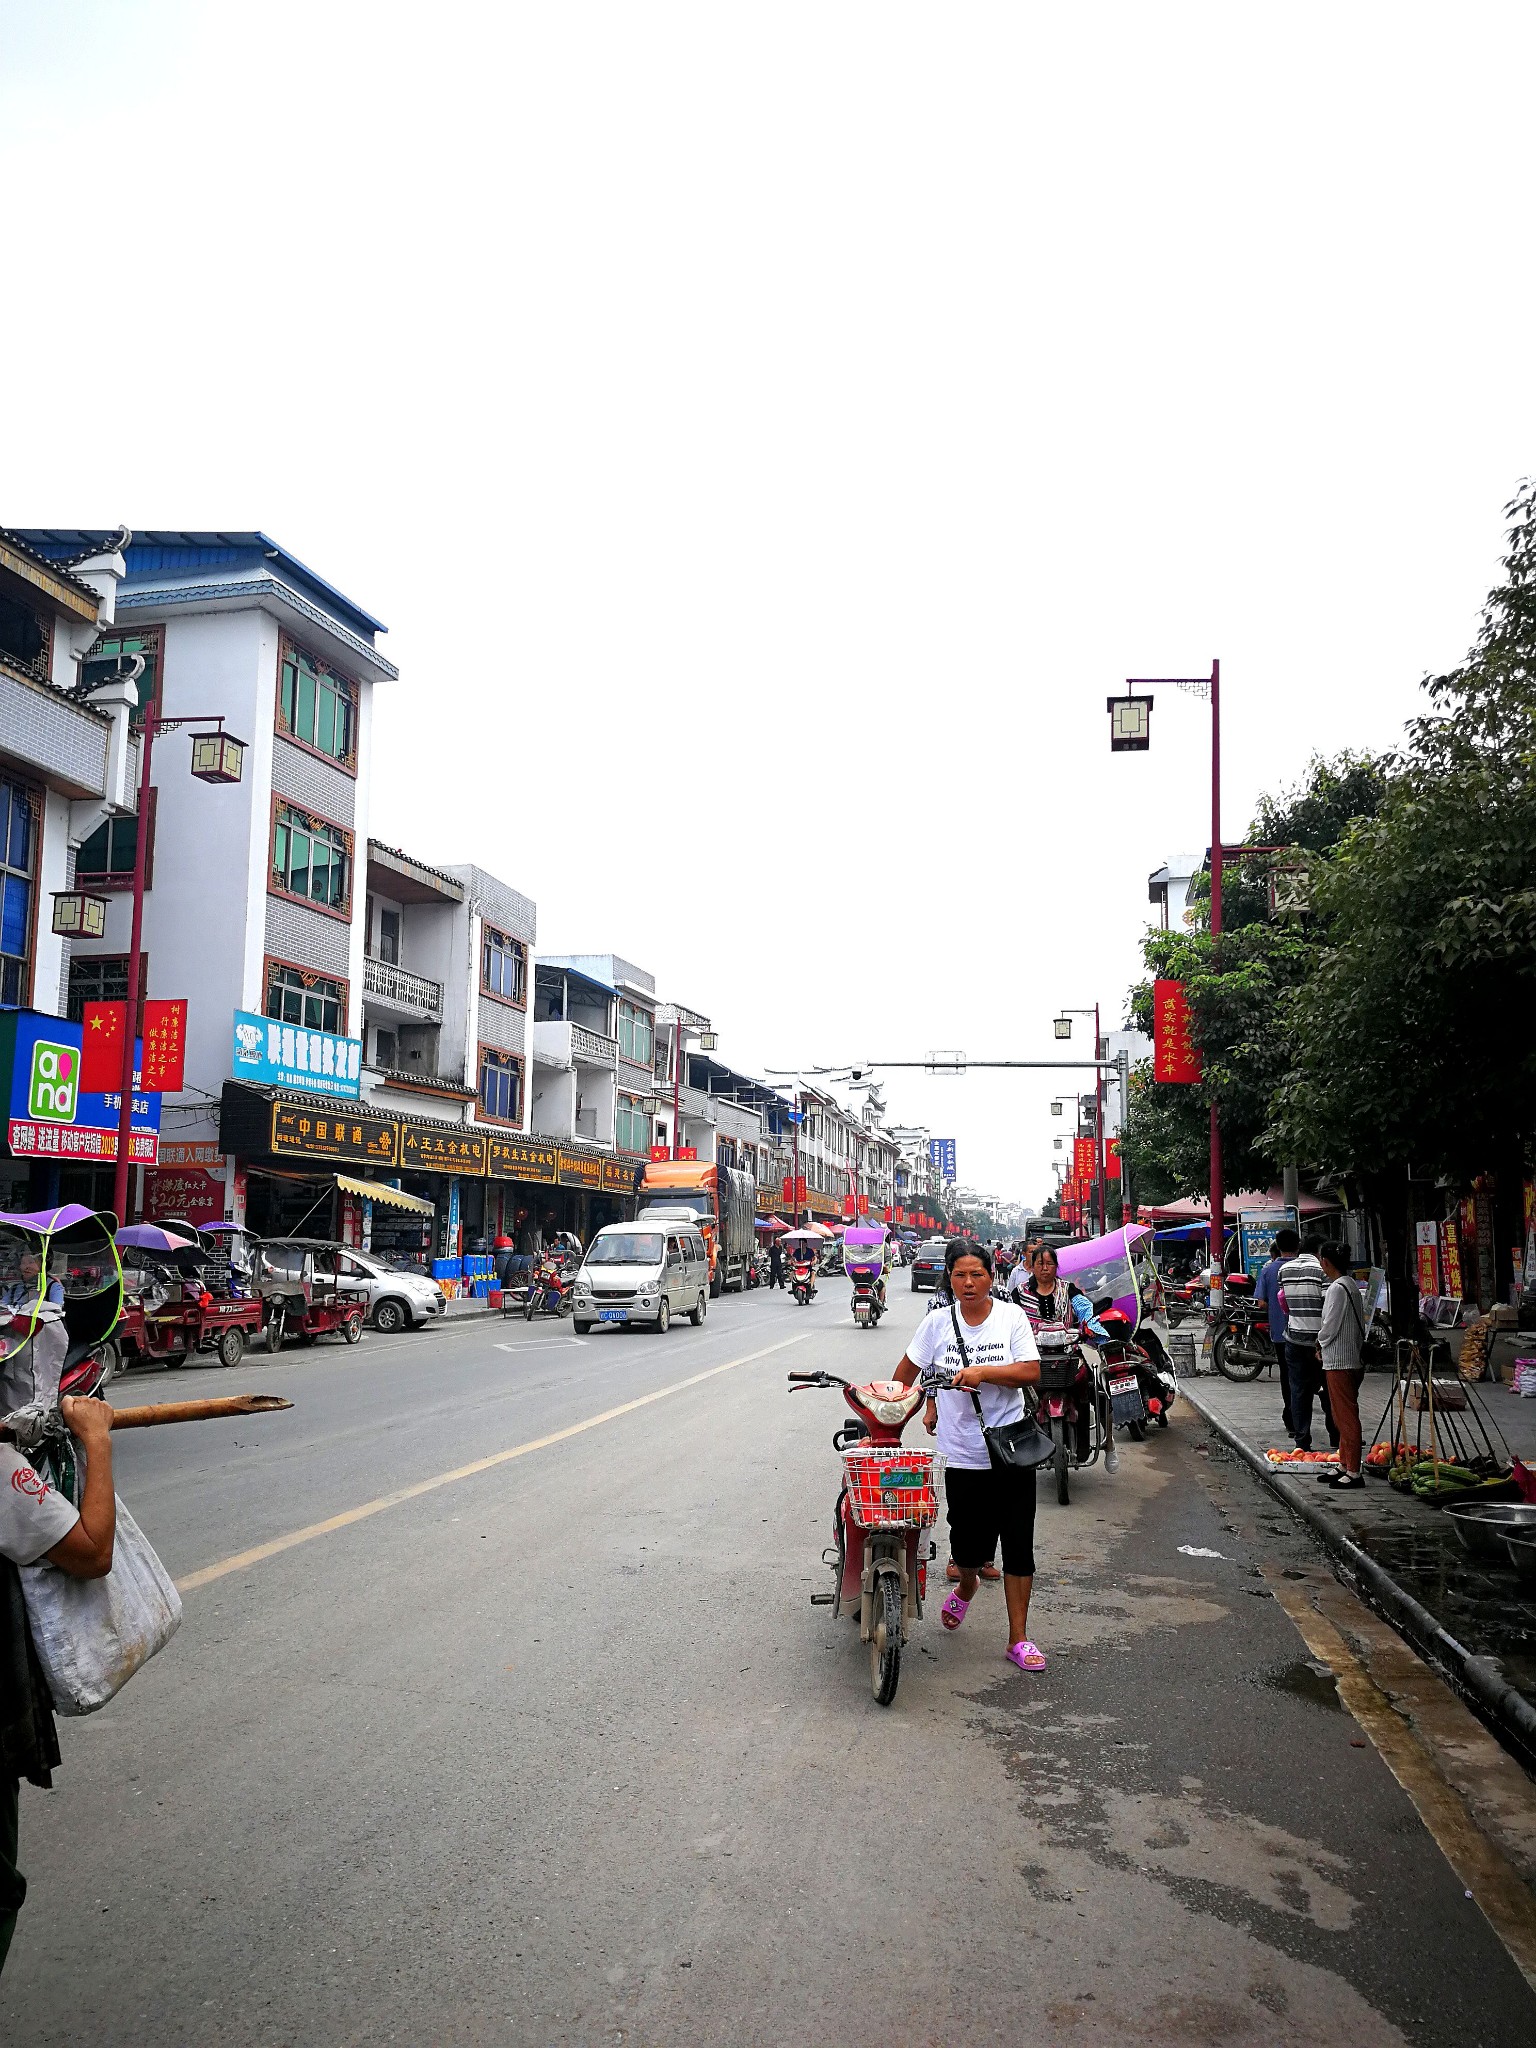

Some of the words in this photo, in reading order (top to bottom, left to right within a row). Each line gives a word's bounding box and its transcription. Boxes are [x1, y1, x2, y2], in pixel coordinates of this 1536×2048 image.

[168, 1004, 180, 1063] 树廉洁之心
[146, 1027, 159, 1087] 做廉洁之人
[158, 1016, 169, 1078] 行廉洁之事
[37, 1128, 59, 1151] 送流量
[299, 1117, 362, 1145] 中国联通
[406, 1134, 482, 1159] 小王五金机电
[944, 1355, 960, 1366] Why
[975, 1354, 1004, 1365] Serious
[964, 1344, 974, 1354] So
[975, 1342, 1004, 1353] Serious
